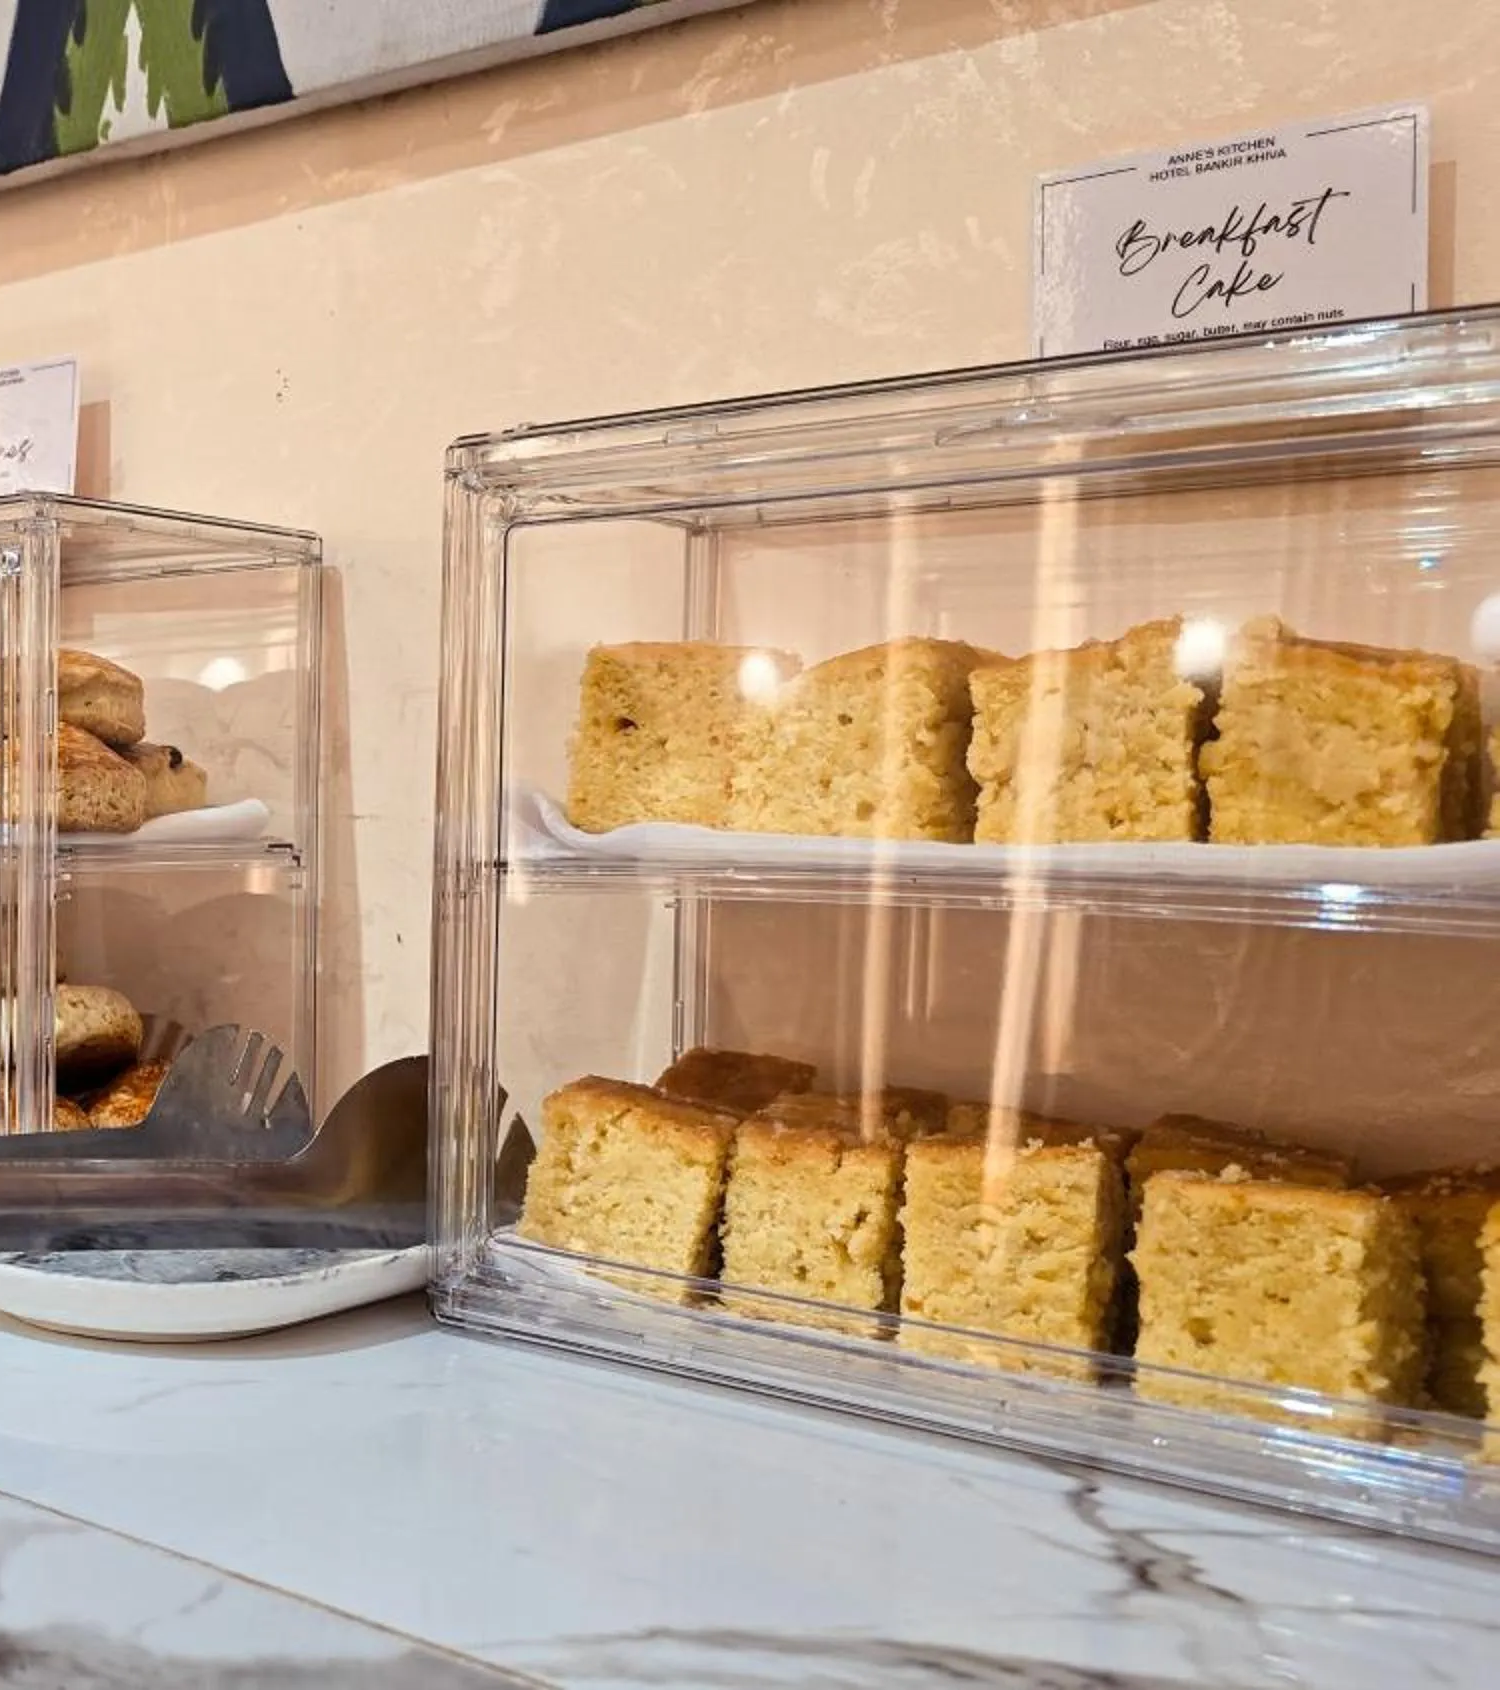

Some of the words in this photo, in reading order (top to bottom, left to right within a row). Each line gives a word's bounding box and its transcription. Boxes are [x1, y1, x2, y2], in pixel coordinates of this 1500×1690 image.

[1149, 166, 1190, 182] HOTEL
[1195, 156, 1243, 174] BANKIR
[1246, 148, 1287, 164] KHIVA
[1167, 147, 1214, 165] ANNE'S
[1217, 136, 1276, 156] KITCHEN
[1116, 188, 1350, 276] Breakfast
[1171, 260, 1285, 318] Cake
[1243, 320, 1267, 331] may
[1271, 311, 1315, 327] contain
[1317, 308, 1345, 321] nuts
